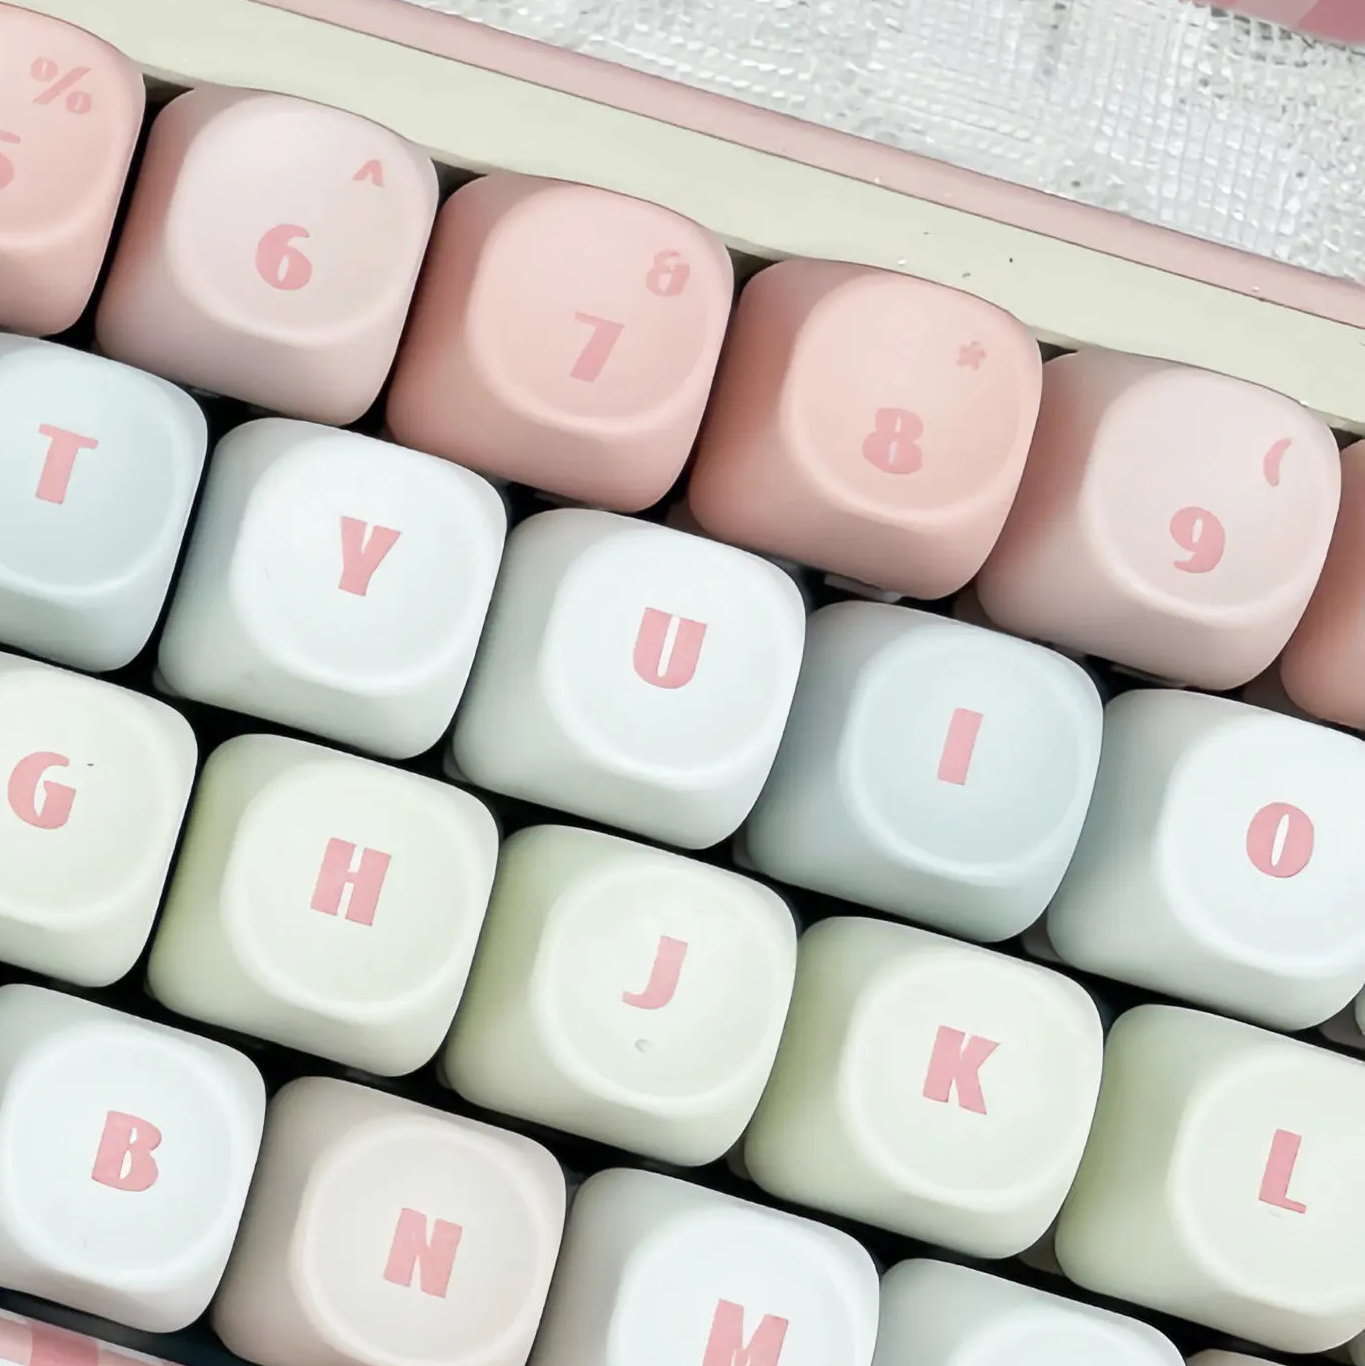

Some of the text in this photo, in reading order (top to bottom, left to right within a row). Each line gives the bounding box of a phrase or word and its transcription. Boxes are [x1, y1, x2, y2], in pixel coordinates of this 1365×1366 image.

[31, 57, 92, 115] %
[255, 223, 313, 291] 6
[569, 311, 625, 383] 7
[35, 423, 99, 506] T
[862, 407, 924, 476] 8
[337, 515, 402, 597] Y
[1169, 506, 1226, 574] 9
[632, 606, 708, 690] U
[7, 751, 77, 830] G
[1246, 801, 1315, 879] O
[310, 837, 392, 927] H
[622, 935, 689, 1010] J
[922, 1024, 1000, 1116] K
[90, 1110, 163, 1193] B
[1258, 1128, 1307, 1215] L
[383, 1207, 463, 1299] N
